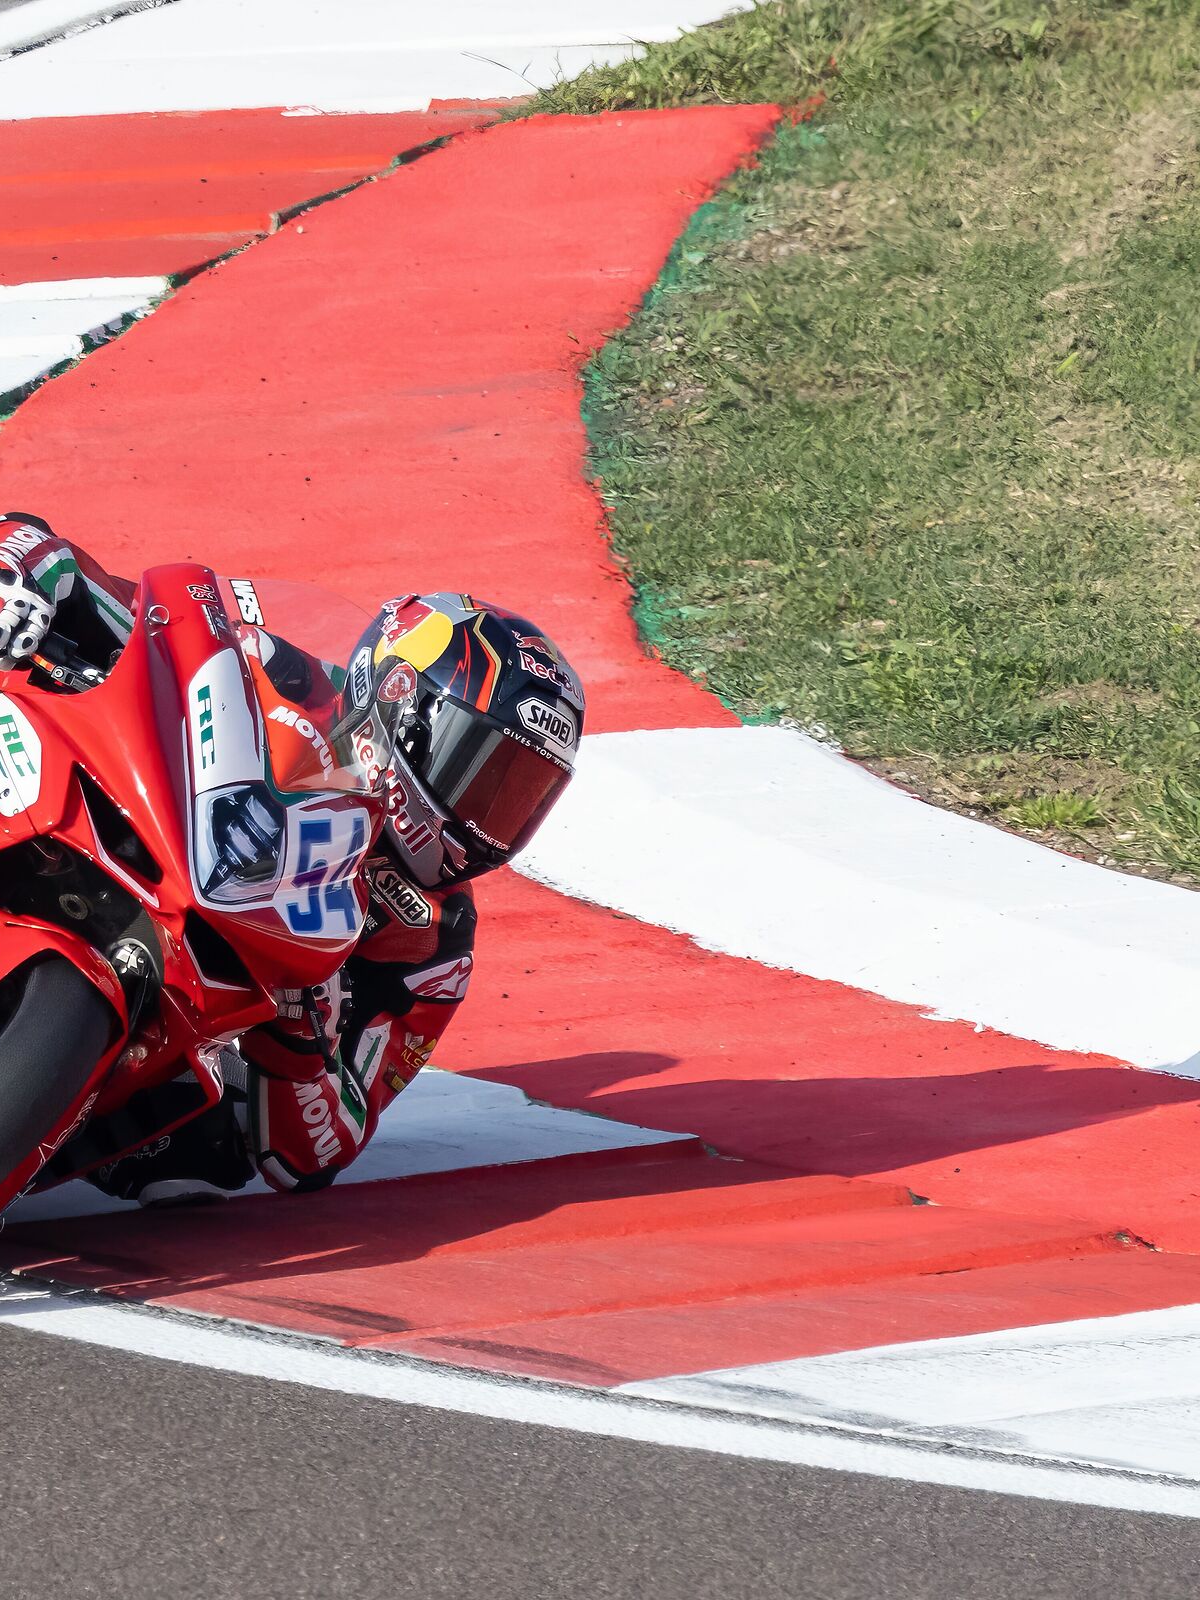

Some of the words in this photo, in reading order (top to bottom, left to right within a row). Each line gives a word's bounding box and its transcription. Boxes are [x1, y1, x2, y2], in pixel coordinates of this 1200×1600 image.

[519, 650, 562, 687] Red
[267, 705, 335, 782] MOTUL
[503, 727, 532, 748] GIVES
[527, 704, 571, 745] SHOEI
[387, 780, 437, 856] Bull
[285, 816, 366, 934] 54
[377, 872, 426, 922] SHOEI
[292, 1081, 342, 1168] MOTUL
